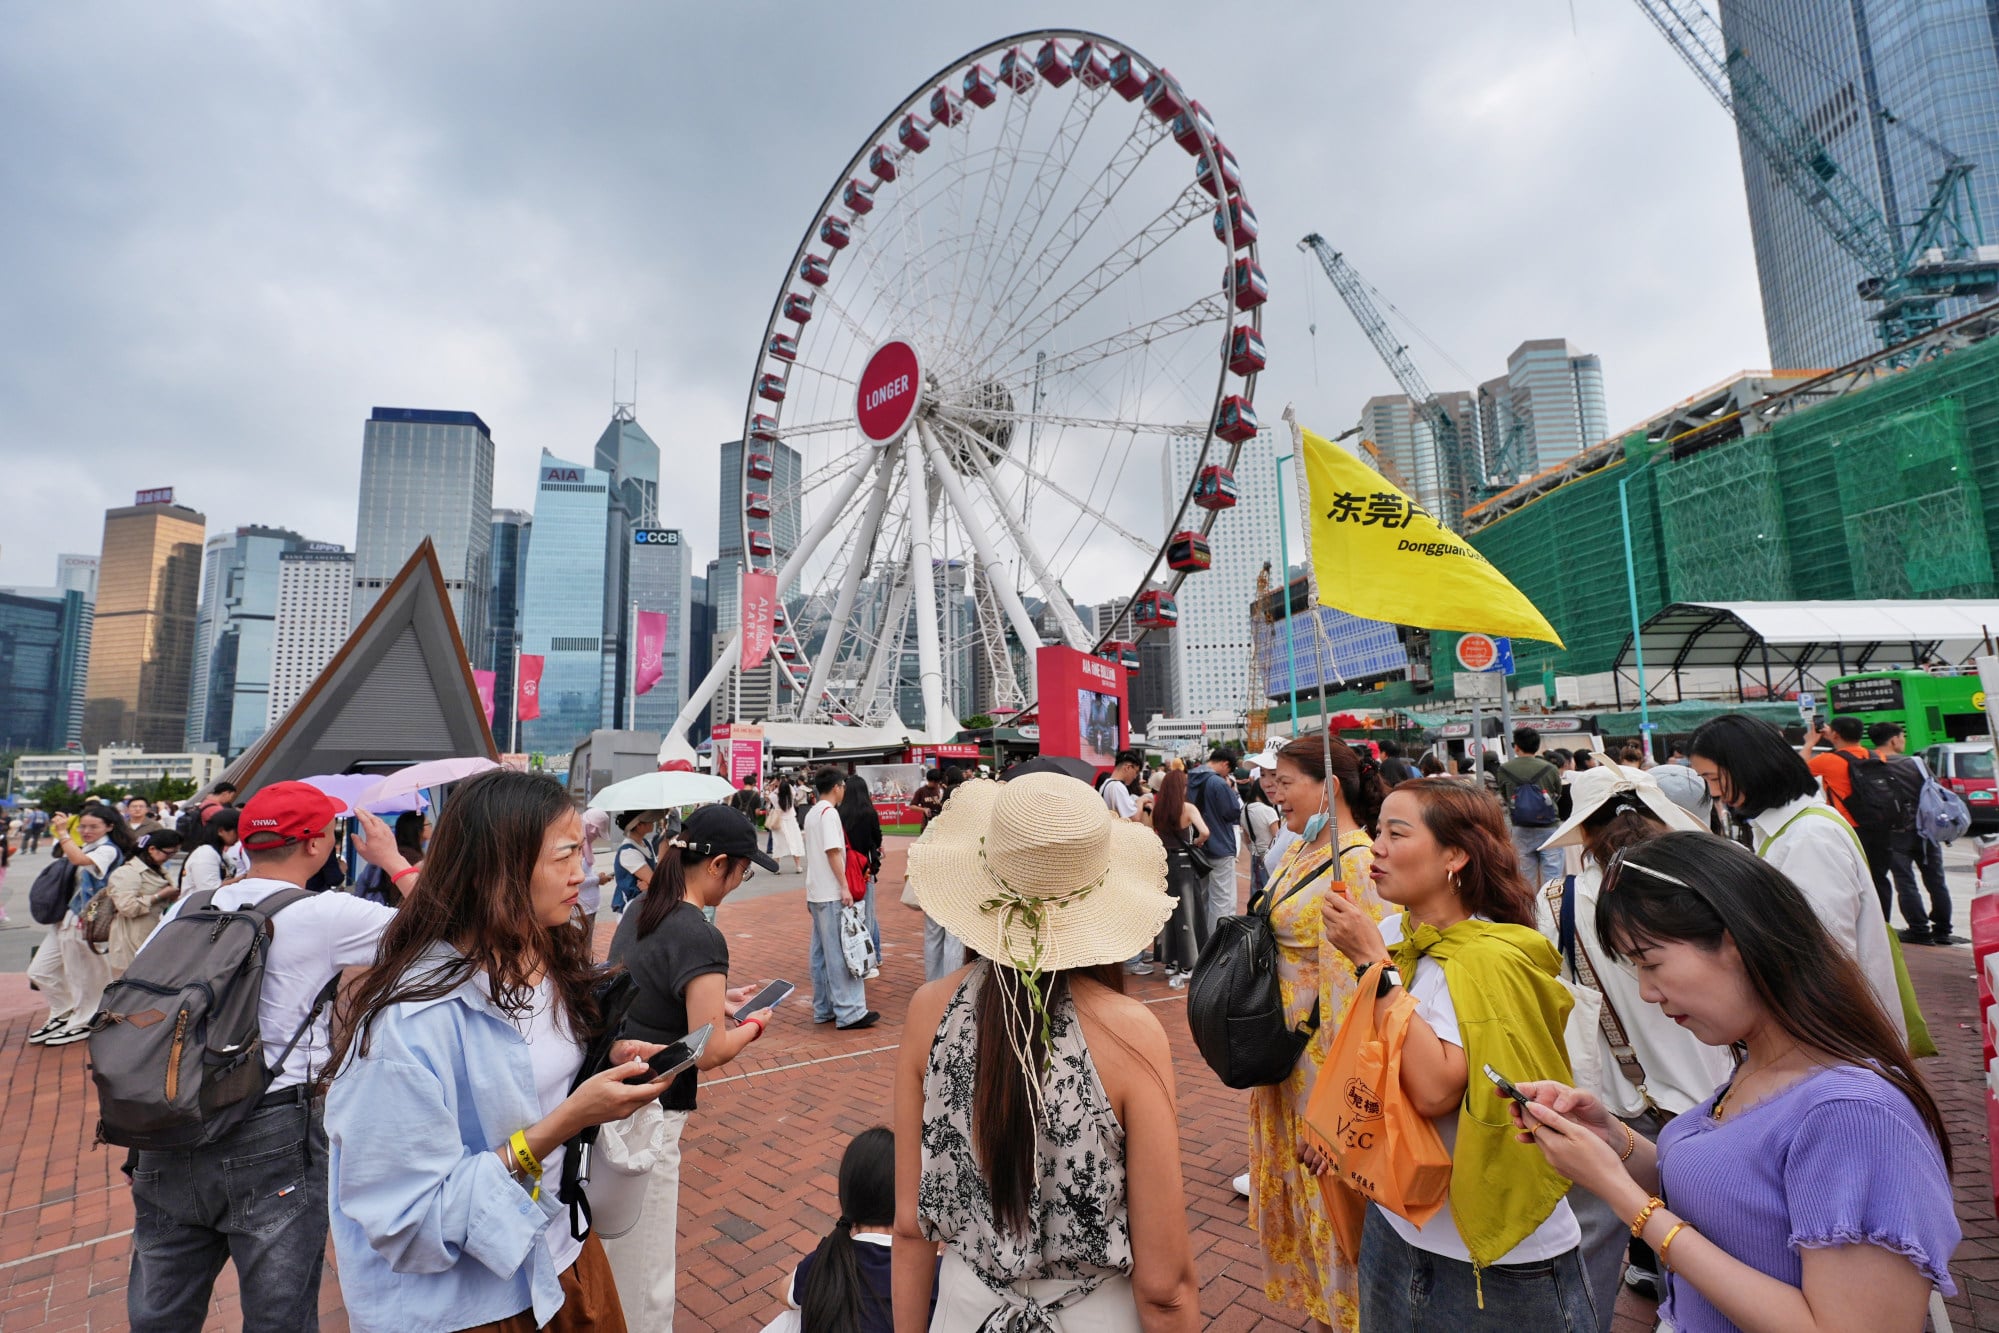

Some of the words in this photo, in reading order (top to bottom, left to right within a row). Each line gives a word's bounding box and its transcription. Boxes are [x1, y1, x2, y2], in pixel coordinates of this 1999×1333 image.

[866, 374, 909, 411] LONGER
[547, 469, 579, 481] AIA
[309, 543, 341, 553] LIPPO
[1397, 539, 1466, 557] Dongguan
[746, 602, 757, 639] PARK
[758, 596, 769, 623] AIA
